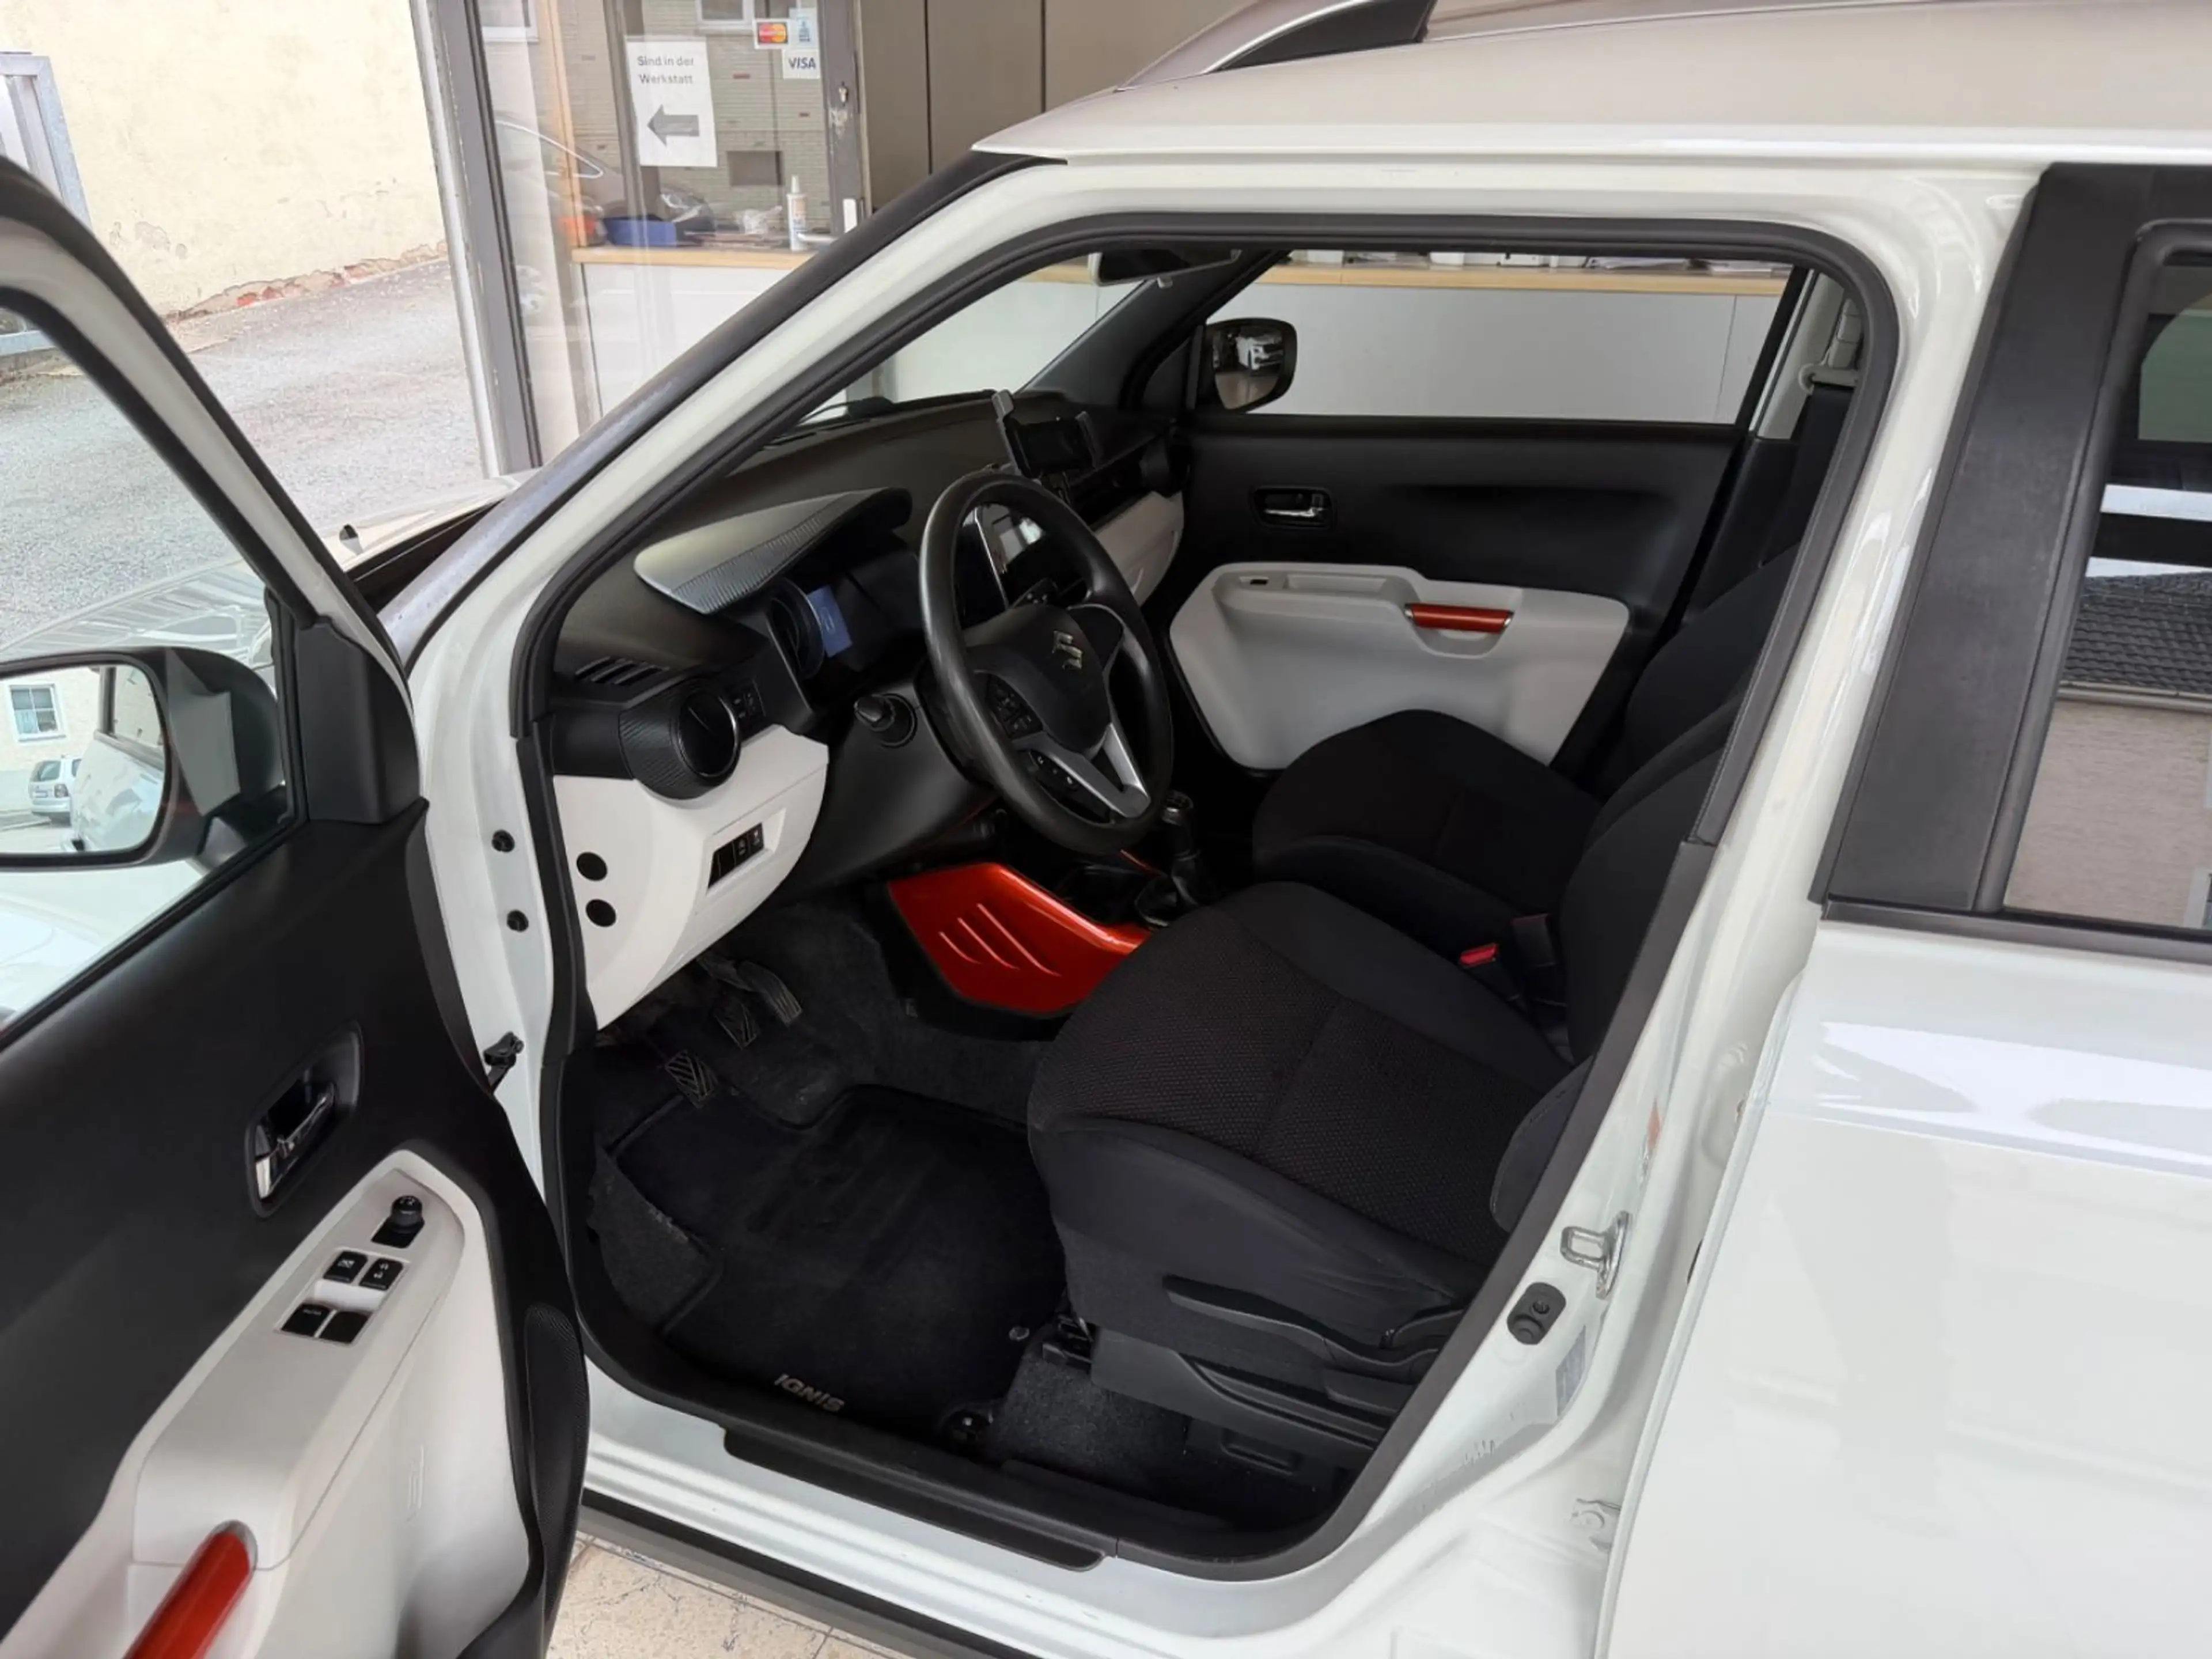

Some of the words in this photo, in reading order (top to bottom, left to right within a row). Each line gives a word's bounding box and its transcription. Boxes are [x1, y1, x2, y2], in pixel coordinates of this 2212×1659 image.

[637, 55, 662, 66] Sind
[664, 56, 675, 66] in
[676, 55, 694, 66] der
[788, 56, 816, 69] VISA
[638, 73, 693, 84] Werkstatt
[774, 1373, 845, 1412] IGNIS
